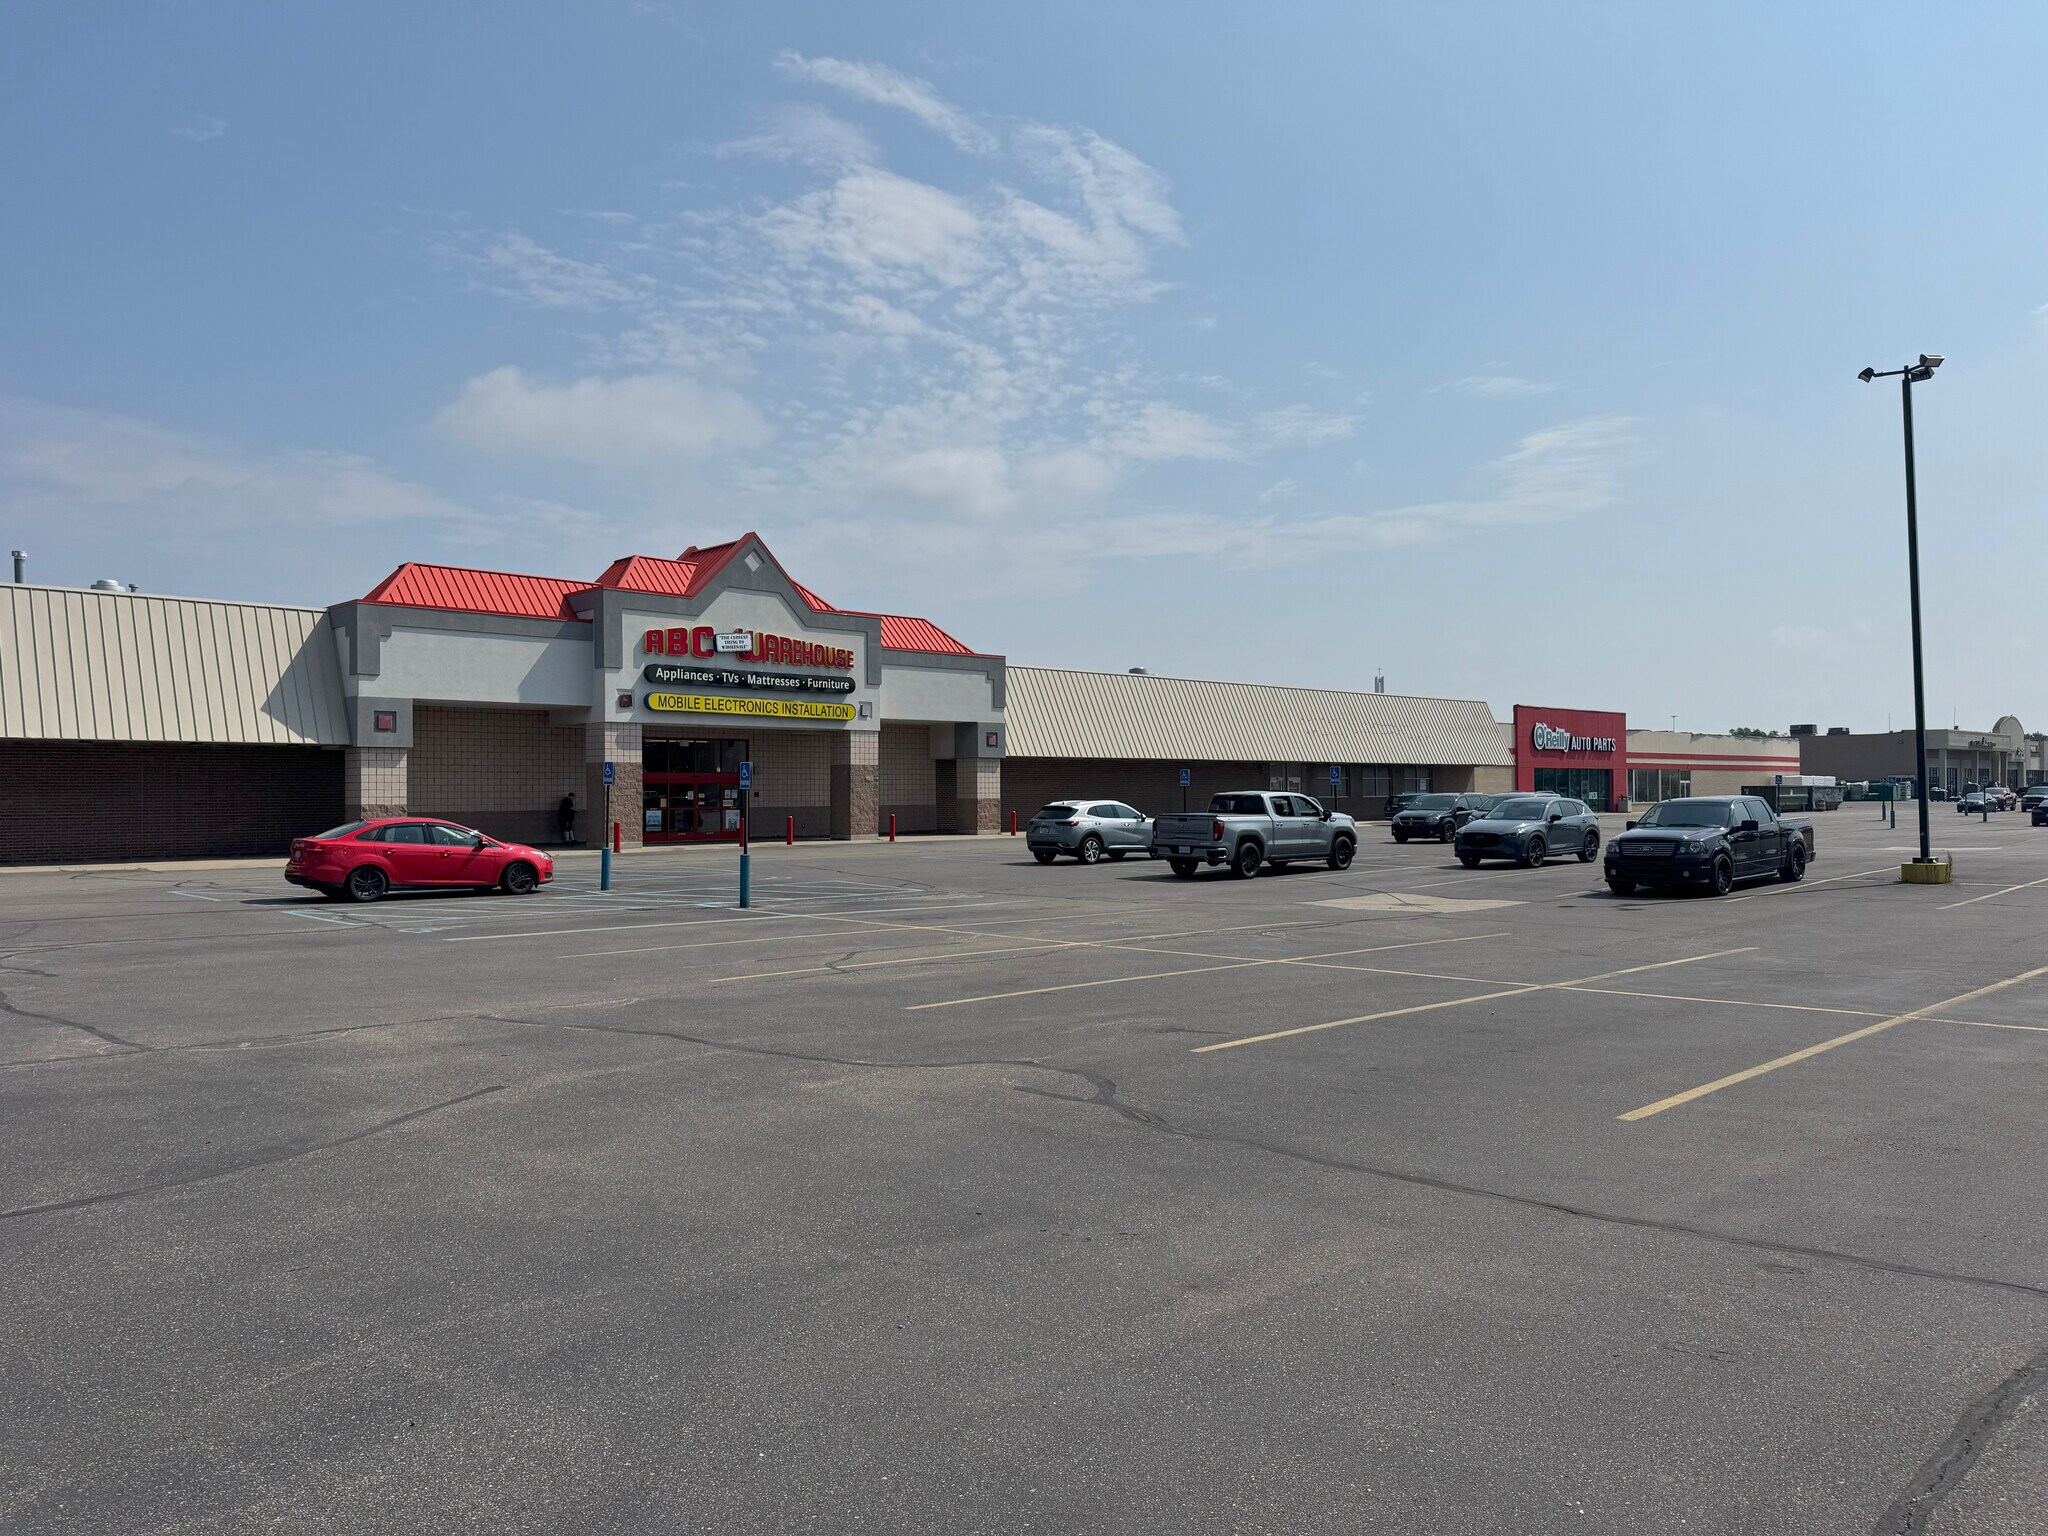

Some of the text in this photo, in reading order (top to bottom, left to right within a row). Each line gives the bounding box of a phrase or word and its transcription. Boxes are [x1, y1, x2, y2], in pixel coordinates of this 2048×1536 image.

[644, 626, 715, 658] ABC
[656, 667, 850, 690] Appliances TVs Mattresses Furniture
[658, 695, 849, 718] MOBILE ELECTRONICS INSTALLATION
[1534, 723, 1617, 752] O'Reilly AUTO PARTS
